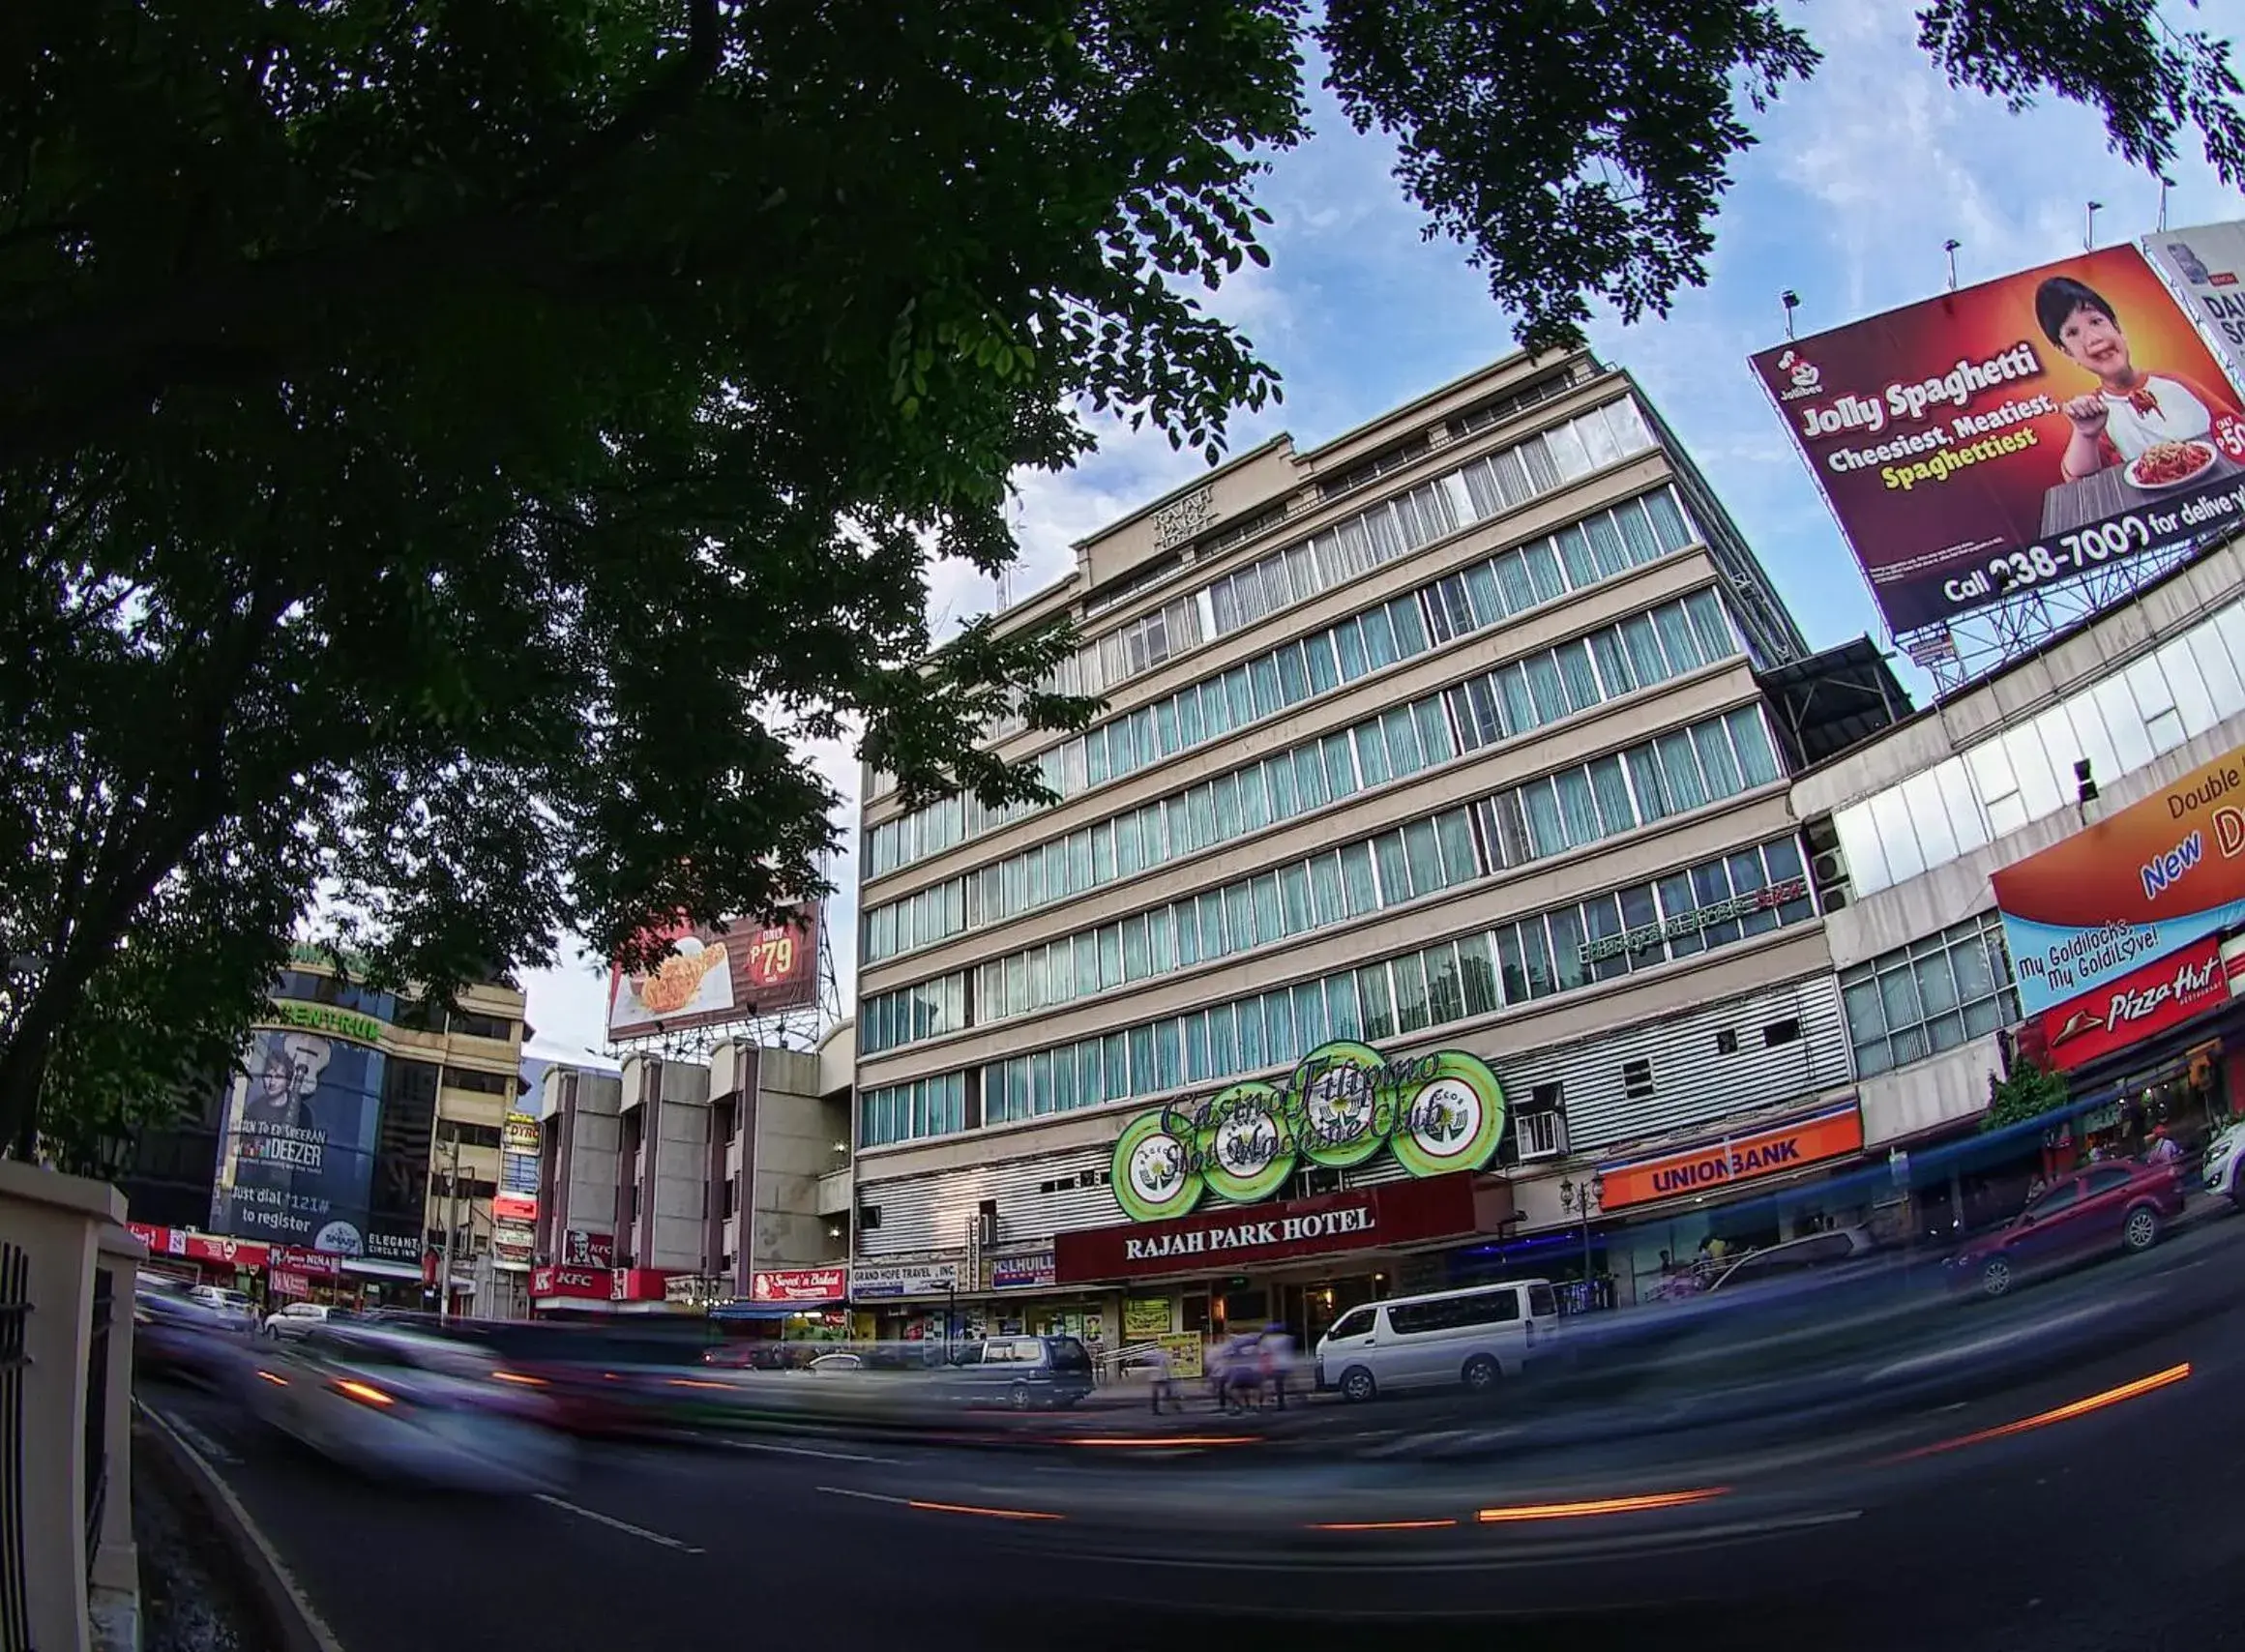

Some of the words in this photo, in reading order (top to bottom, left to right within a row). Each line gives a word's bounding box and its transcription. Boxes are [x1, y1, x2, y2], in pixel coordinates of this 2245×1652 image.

[2202, 292, 2245, 319] DAI
[1780, 385, 1823, 402] Jollibee
[1802, 394, 1883, 437] Jolly
[1885, 342, 2040, 418] Spaghetti
[1828, 425, 1955, 473] Cheesiest,
[1952, 393, 2060, 438] Meatiest,
[1880, 426, 2038, 490] Spaghettiest
[1943, 569, 1991, 602] Call
[2148, 512, 2179, 535] for
[2167, 769, 2240, 819] Double
[2141, 831, 2201, 900] New
[762, 926, 784, 942] ONLY
[2107, 987, 2171, 1032] Pizza
[2170, 957, 2220, 999] Hut
[1162, 1087, 1287, 1136] Casino
[1287, 1053, 1440, 1119] Filipino
[1370, 1082, 1444, 1139] Club
[271, 1137, 322, 1167] DEEZER
[1652, 1137, 1800, 1193] UNIONBANK
[243, 1207, 255, 1222] to
[257, 1210, 311, 1233] register
[256, 1187, 281, 1204] dial
[369, 1232, 419, 1250] ELEGANT
[589, 1244, 612, 1255] KFC
[1125, 1231, 1204, 1260] RAJAH
[1209, 1222, 1279, 1251] PARK
[1282, 1207, 1375, 1241] HOTEL
[556, 1272, 594, 1287] KFC
[854, 1269, 878, 1282] GRAND
[880, 1268, 901, 1281] HOPE
[901, 1266, 931, 1280] TRAVEL
